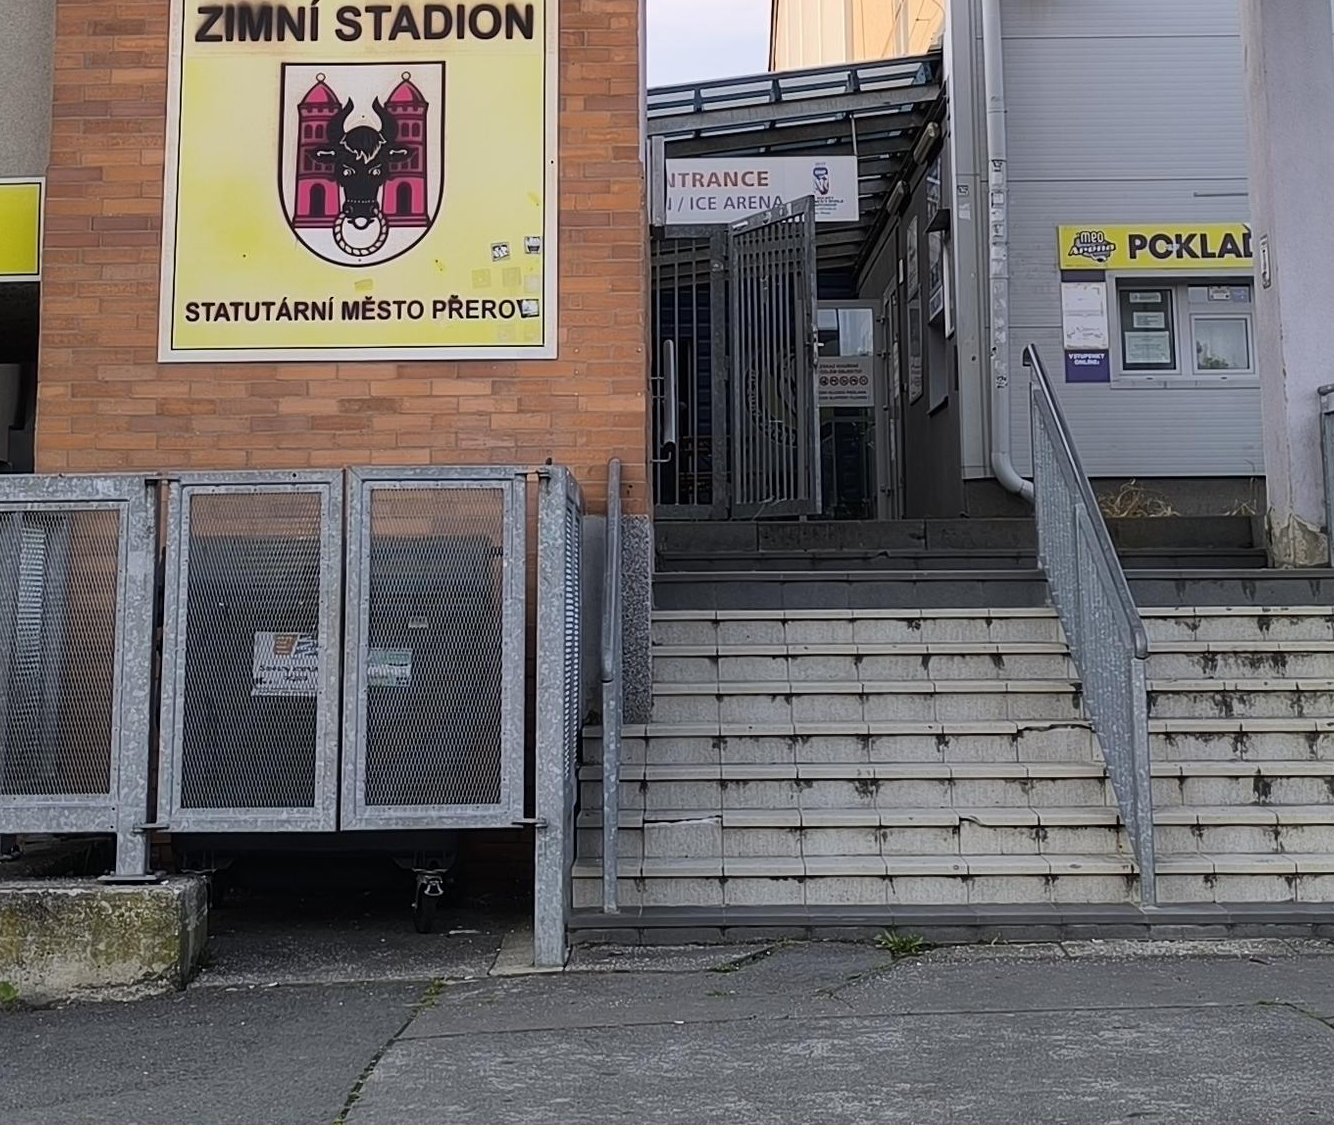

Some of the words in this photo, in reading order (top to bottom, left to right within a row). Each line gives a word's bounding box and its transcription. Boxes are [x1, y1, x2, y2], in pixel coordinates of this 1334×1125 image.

[334, 3, 534, 41] STADION
[667, 171, 769, 188] NTRANCE
[690, 196, 717, 211] ICE
[723, 195, 783, 210] ARENA
[185, 296, 334, 322] STATUTÁRNÍ
[341, 295, 425, 321] MĚSTO
